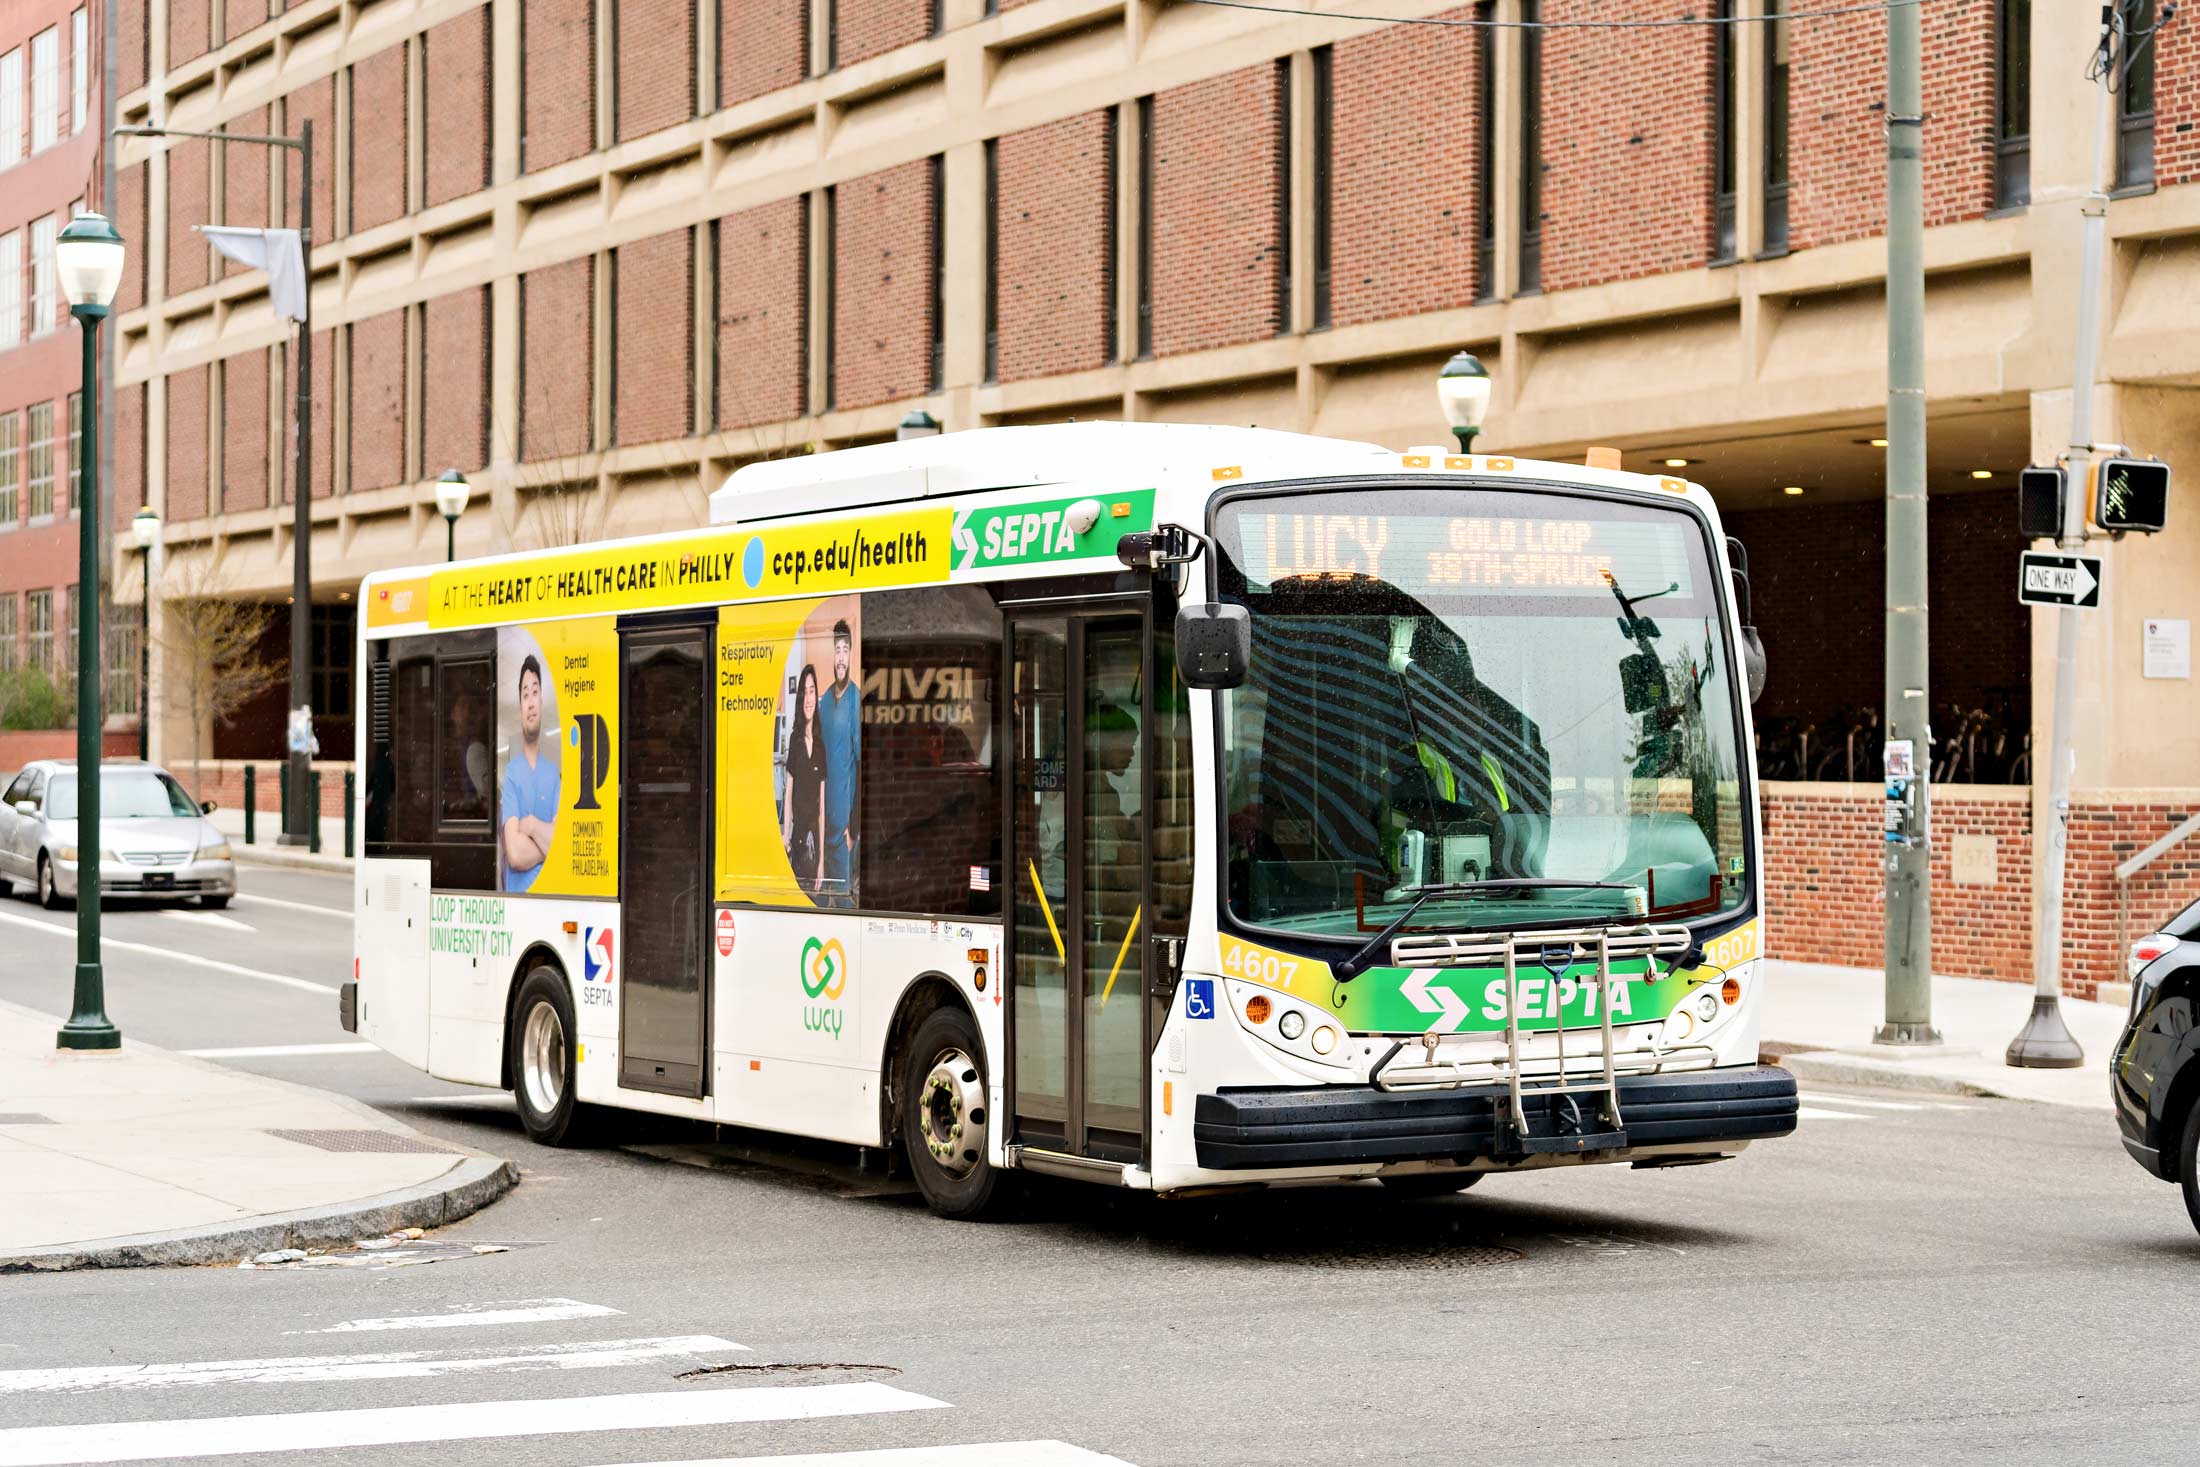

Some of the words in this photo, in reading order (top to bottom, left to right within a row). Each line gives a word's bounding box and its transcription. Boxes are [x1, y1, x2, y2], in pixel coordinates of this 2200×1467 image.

[983, 511, 1075, 560] SEPTA
[1266, 514, 1387, 581] LUCY
[1448, 518, 1517, 552] GOLD
[1525, 520, 1591, 554] LOOP
[772, 529, 927, 585] ccp.edu/health
[443, 586, 458, 611] AT
[463, 583, 485, 608] THE
[488, 577, 532, 606] HEART
[536, 574, 553, 601] OF
[661, 559, 675, 588] IN
[679, 552, 734, 585] PHILLY
[2030, 569, 2050, 588] ONE
[2054, 571, 2076, 591] WAY
[564, 653, 589, 670] Dental
[721, 645, 774, 666] Respiratory
[564, 678, 595, 698] Hygiene
[721, 671, 744, 686] Care
[721, 695, 774, 715] Technology
[572, 821, 604, 838] COMMUNITY
[572, 840, 595, 857] COLLEGE
[596, 842, 602, 857] OF
[572, 859, 609, 876] PHILADELPHIA
[431, 896, 456, 923] LOOP
[458, 899, 505, 925] THROUGH
[431, 927, 487, 955] UNIVERSITY
[490, 931, 513, 957] CITY
[956, 927, 974, 941] uCity
[1705, 930, 1754, 966] 4607
[1225, 945, 1299, 988] 4607
[583, 986, 613, 1007] SEPTA
[1481, 979, 1632, 1021] SEPTA
[804, 1006, 842, 1040] LUCY
